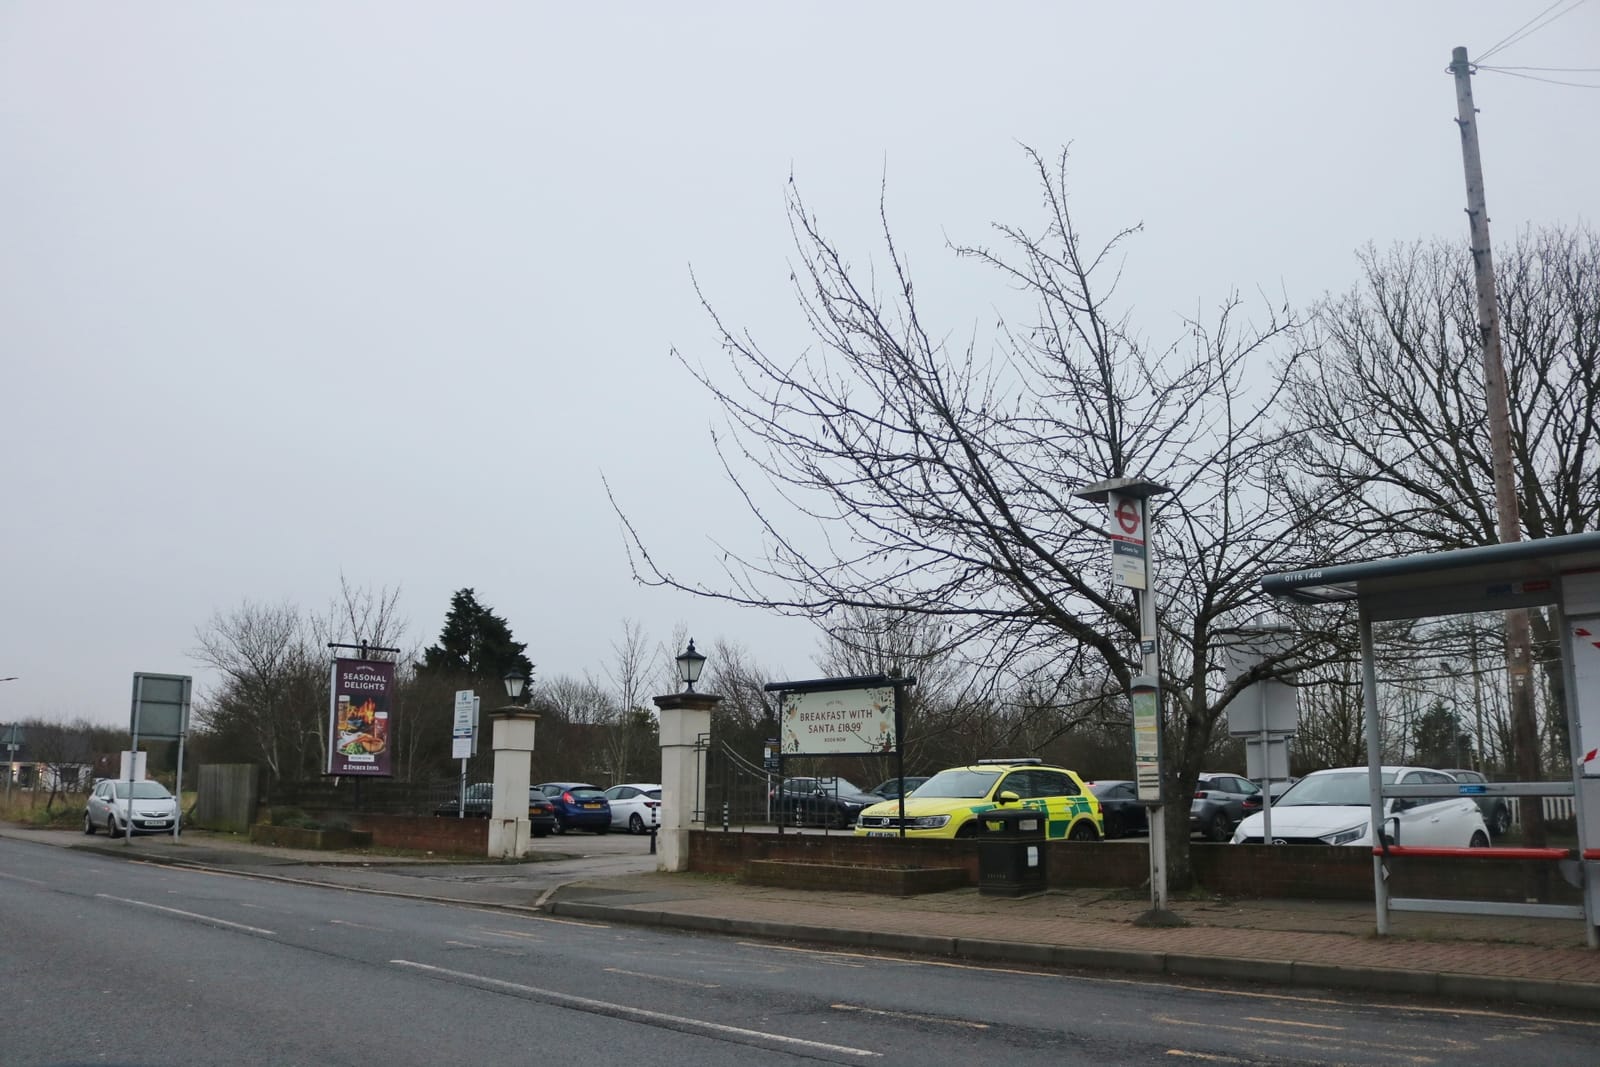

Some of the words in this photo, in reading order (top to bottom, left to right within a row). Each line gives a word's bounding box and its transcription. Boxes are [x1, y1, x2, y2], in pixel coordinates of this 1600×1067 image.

[1284, 574, 1303, 582] 0116
[343, 672, 387, 682] SEASONAL
[344, 681, 385, 690] DELIGHTS
[800, 710, 846, 721] BREAKFAST
[848, 709, 873, 719] WITH
[808, 724, 835, 733] SANTA
